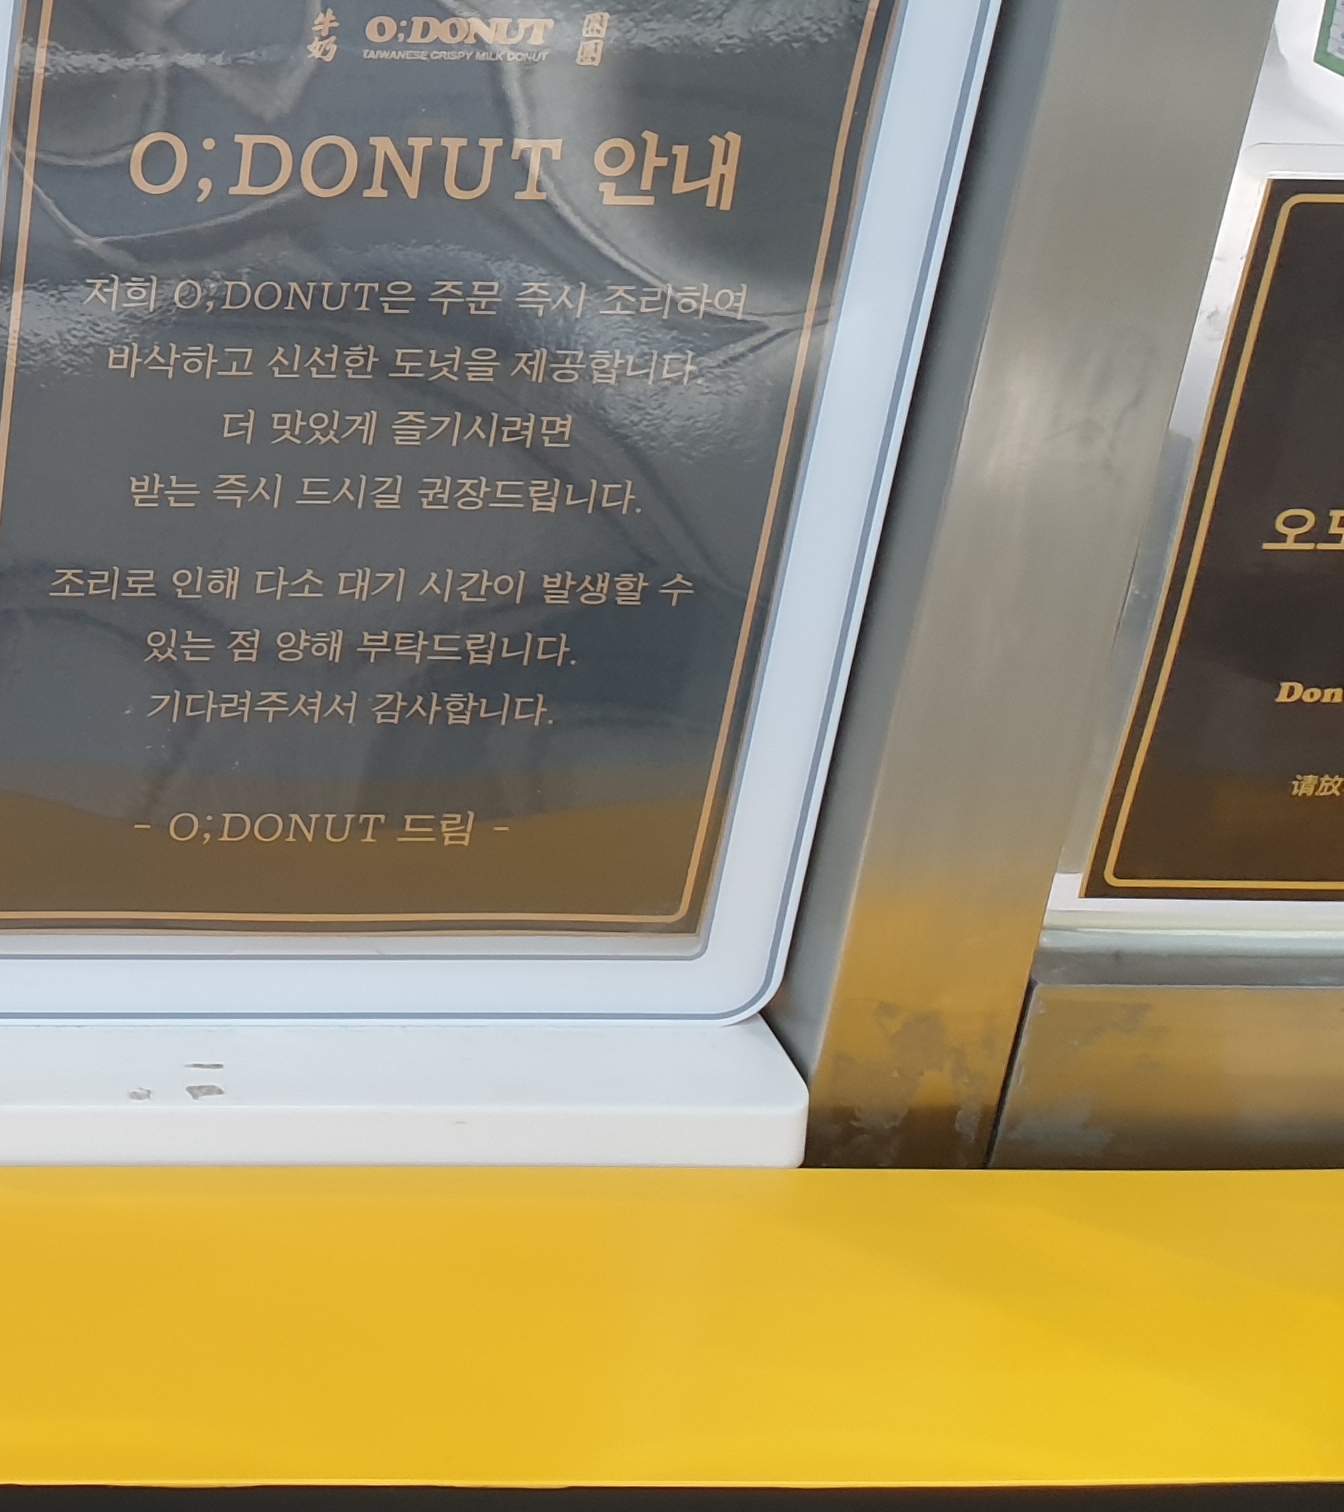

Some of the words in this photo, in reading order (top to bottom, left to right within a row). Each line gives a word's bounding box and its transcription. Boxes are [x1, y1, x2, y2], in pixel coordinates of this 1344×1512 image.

[365, 15, 555, 46] O;DONUT
[363, 48, 429, 61] TAIWANESE
[430, 49, 474, 62] CRISPY
[475, 50, 504, 62] MILK
[507, 51, 550, 62] DONUT
[128, 129, 562, 203] O;DONUT
[592, 129, 744, 212] 안내
[82, 273, 158, 313] 저희
[173, 279, 416, 315] O;DONUT은
[427, 280, 503, 316] 주문
[515, 281, 588, 318] 즉시
[598, 282, 749, 320] 조리하여
[107, 342, 254, 380] 바삭하고
[267, 342, 379, 380] 신선한
[388, 345, 501, 383] 도넛을
[222, 409, 256, 445] 더
[270, 409, 378, 446] 맛있게
[390, 410, 574, 449] 즐기시려면
[129, 472, 200, 508] 받는
[212, 472, 283, 509] 즉시
[295, 473, 403, 510] 드시길
[417, 474, 643, 515] 권장드립니다.
[48, 565, 157, 601] 조리로
[171, 566, 241, 601] 인해
[254, 566, 324, 601] 다소
[337, 566, 406, 602] 대기
[418, 567, 526, 604] 시간이
[541, 569, 649, 606] 발생할
[658, 572, 695, 607] 수
[143, 628, 216, 663] 있는
[226, 628, 261, 663] 점
[275, 628, 344, 664] 양해
[356, 629, 577, 667] 부탁드립니다.
[146, 688, 359, 725] 기다려주셔서
[371, 689, 554, 727] 감사합니다.
[168, 811, 386, 846] O;DONUT
[396, 809, 475, 847] 드림
